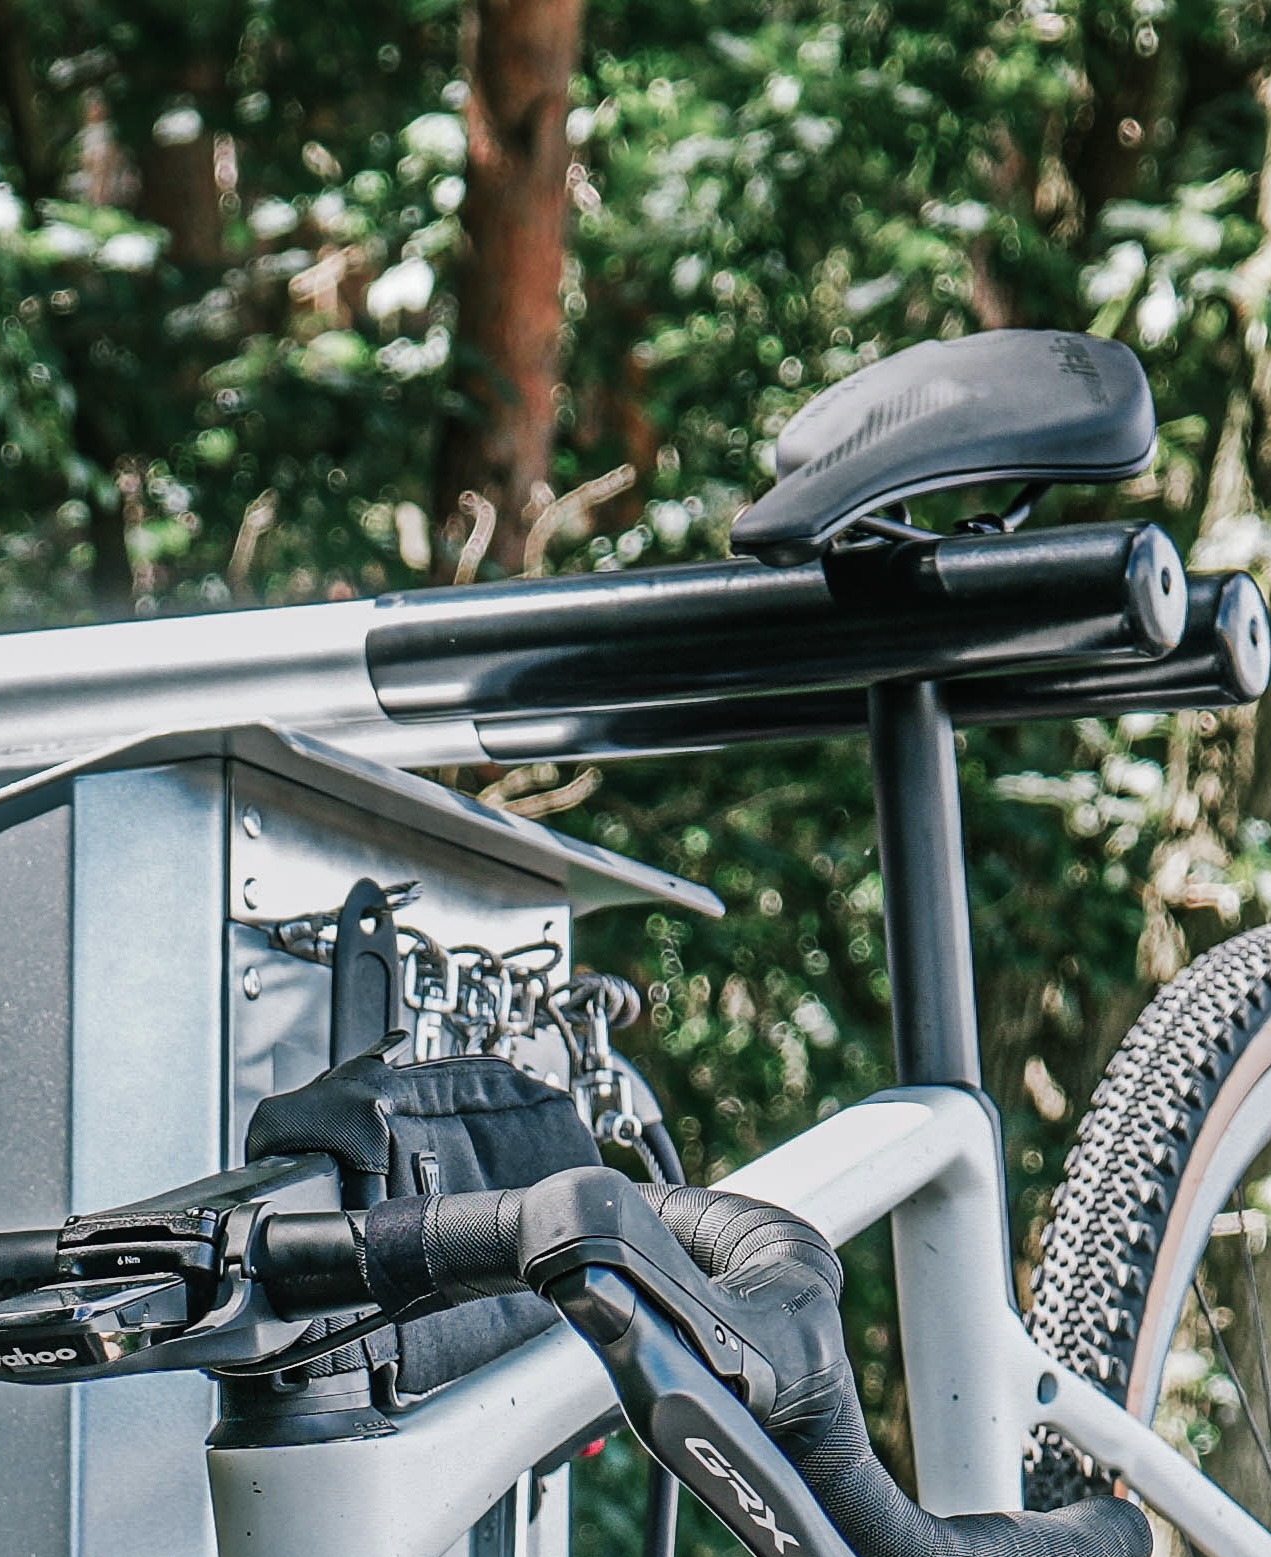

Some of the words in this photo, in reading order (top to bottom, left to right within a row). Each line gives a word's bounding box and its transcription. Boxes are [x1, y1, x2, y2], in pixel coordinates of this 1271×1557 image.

[117, 1256, 124, 1266] 6
[124, 1256, 141, 1265] Nm
[685, 1438, 800, 1555] GRX
